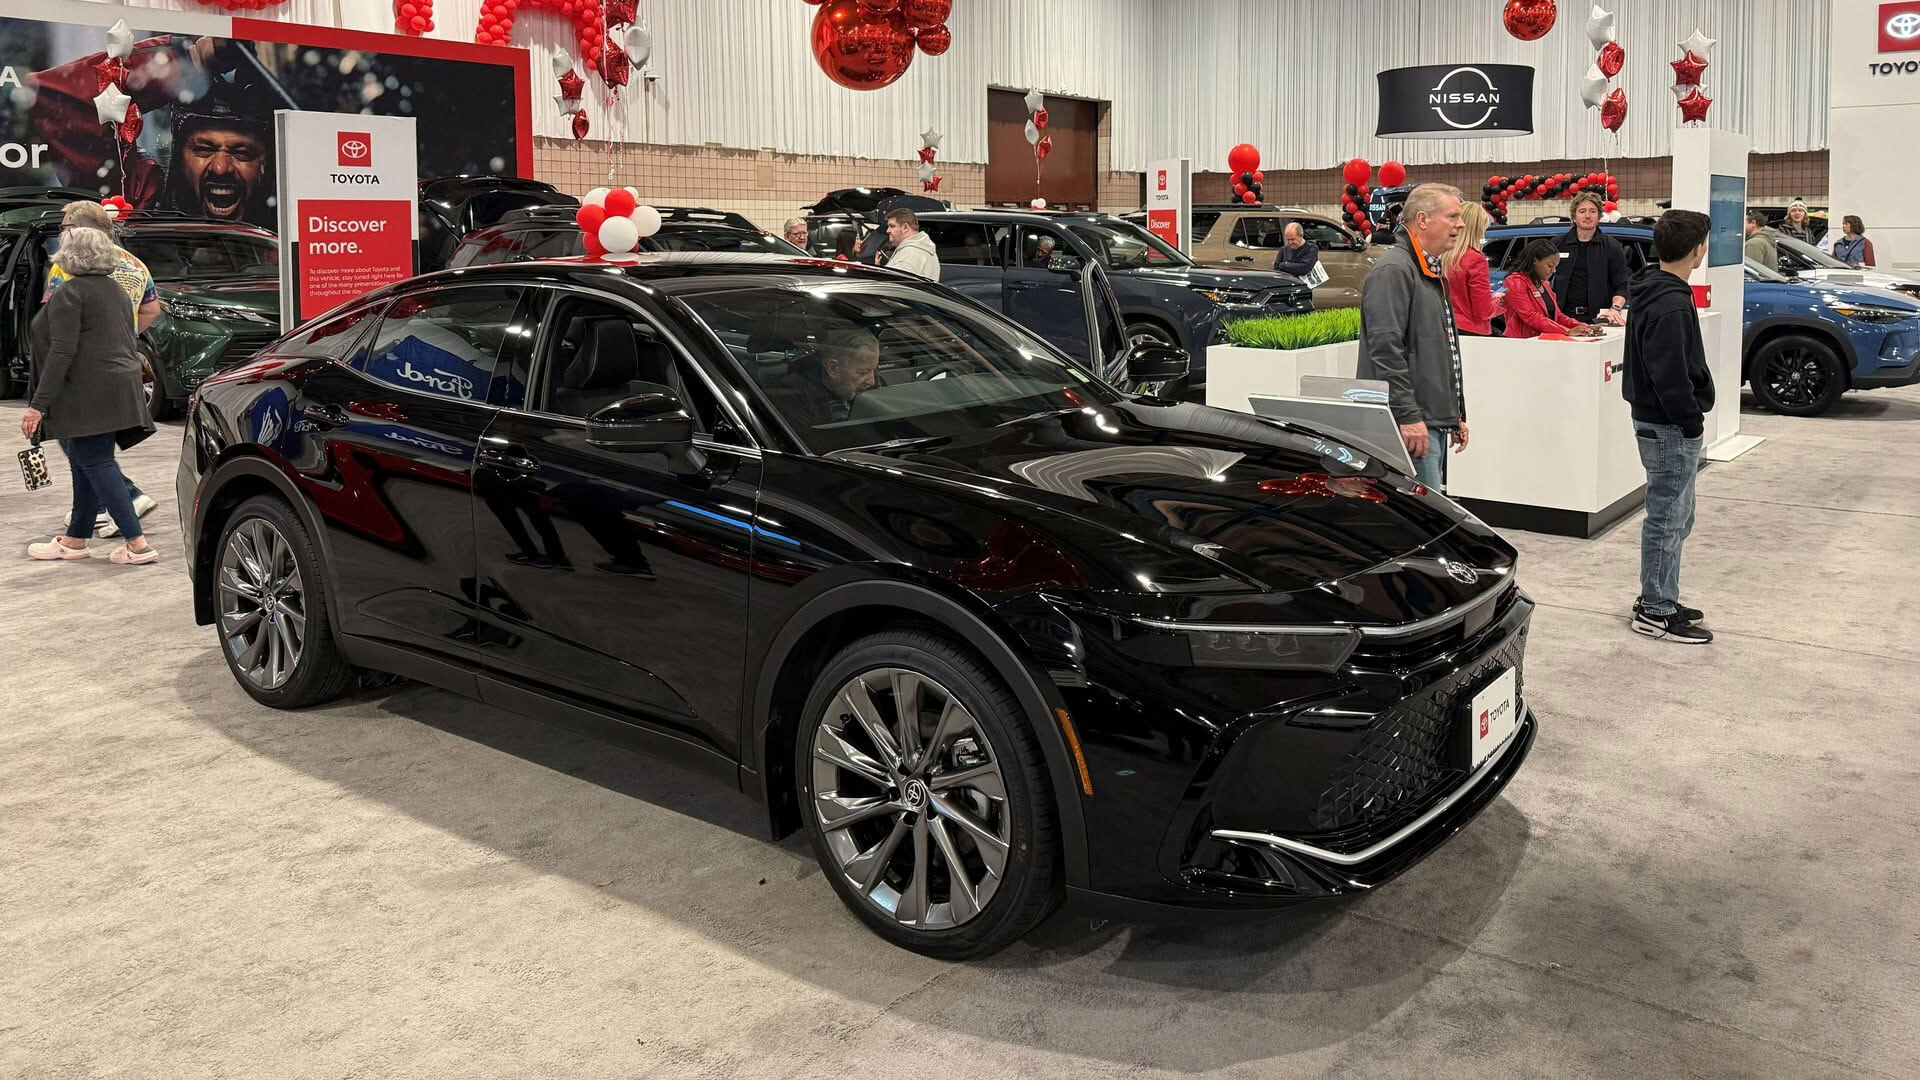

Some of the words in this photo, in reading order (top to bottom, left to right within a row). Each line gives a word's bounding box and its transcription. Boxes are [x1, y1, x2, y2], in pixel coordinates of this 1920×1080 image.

[1869, 61, 1920, 76] TOYO
[1429, 93, 1500, 104] NISSAN
[330, 174, 380, 185] TOYOTA
[309, 216, 387, 233] Discover
[1151, 219, 1171, 229] Discover
[309, 241, 363, 255] more.
[1490, 699, 1510, 724] TOYOTA
